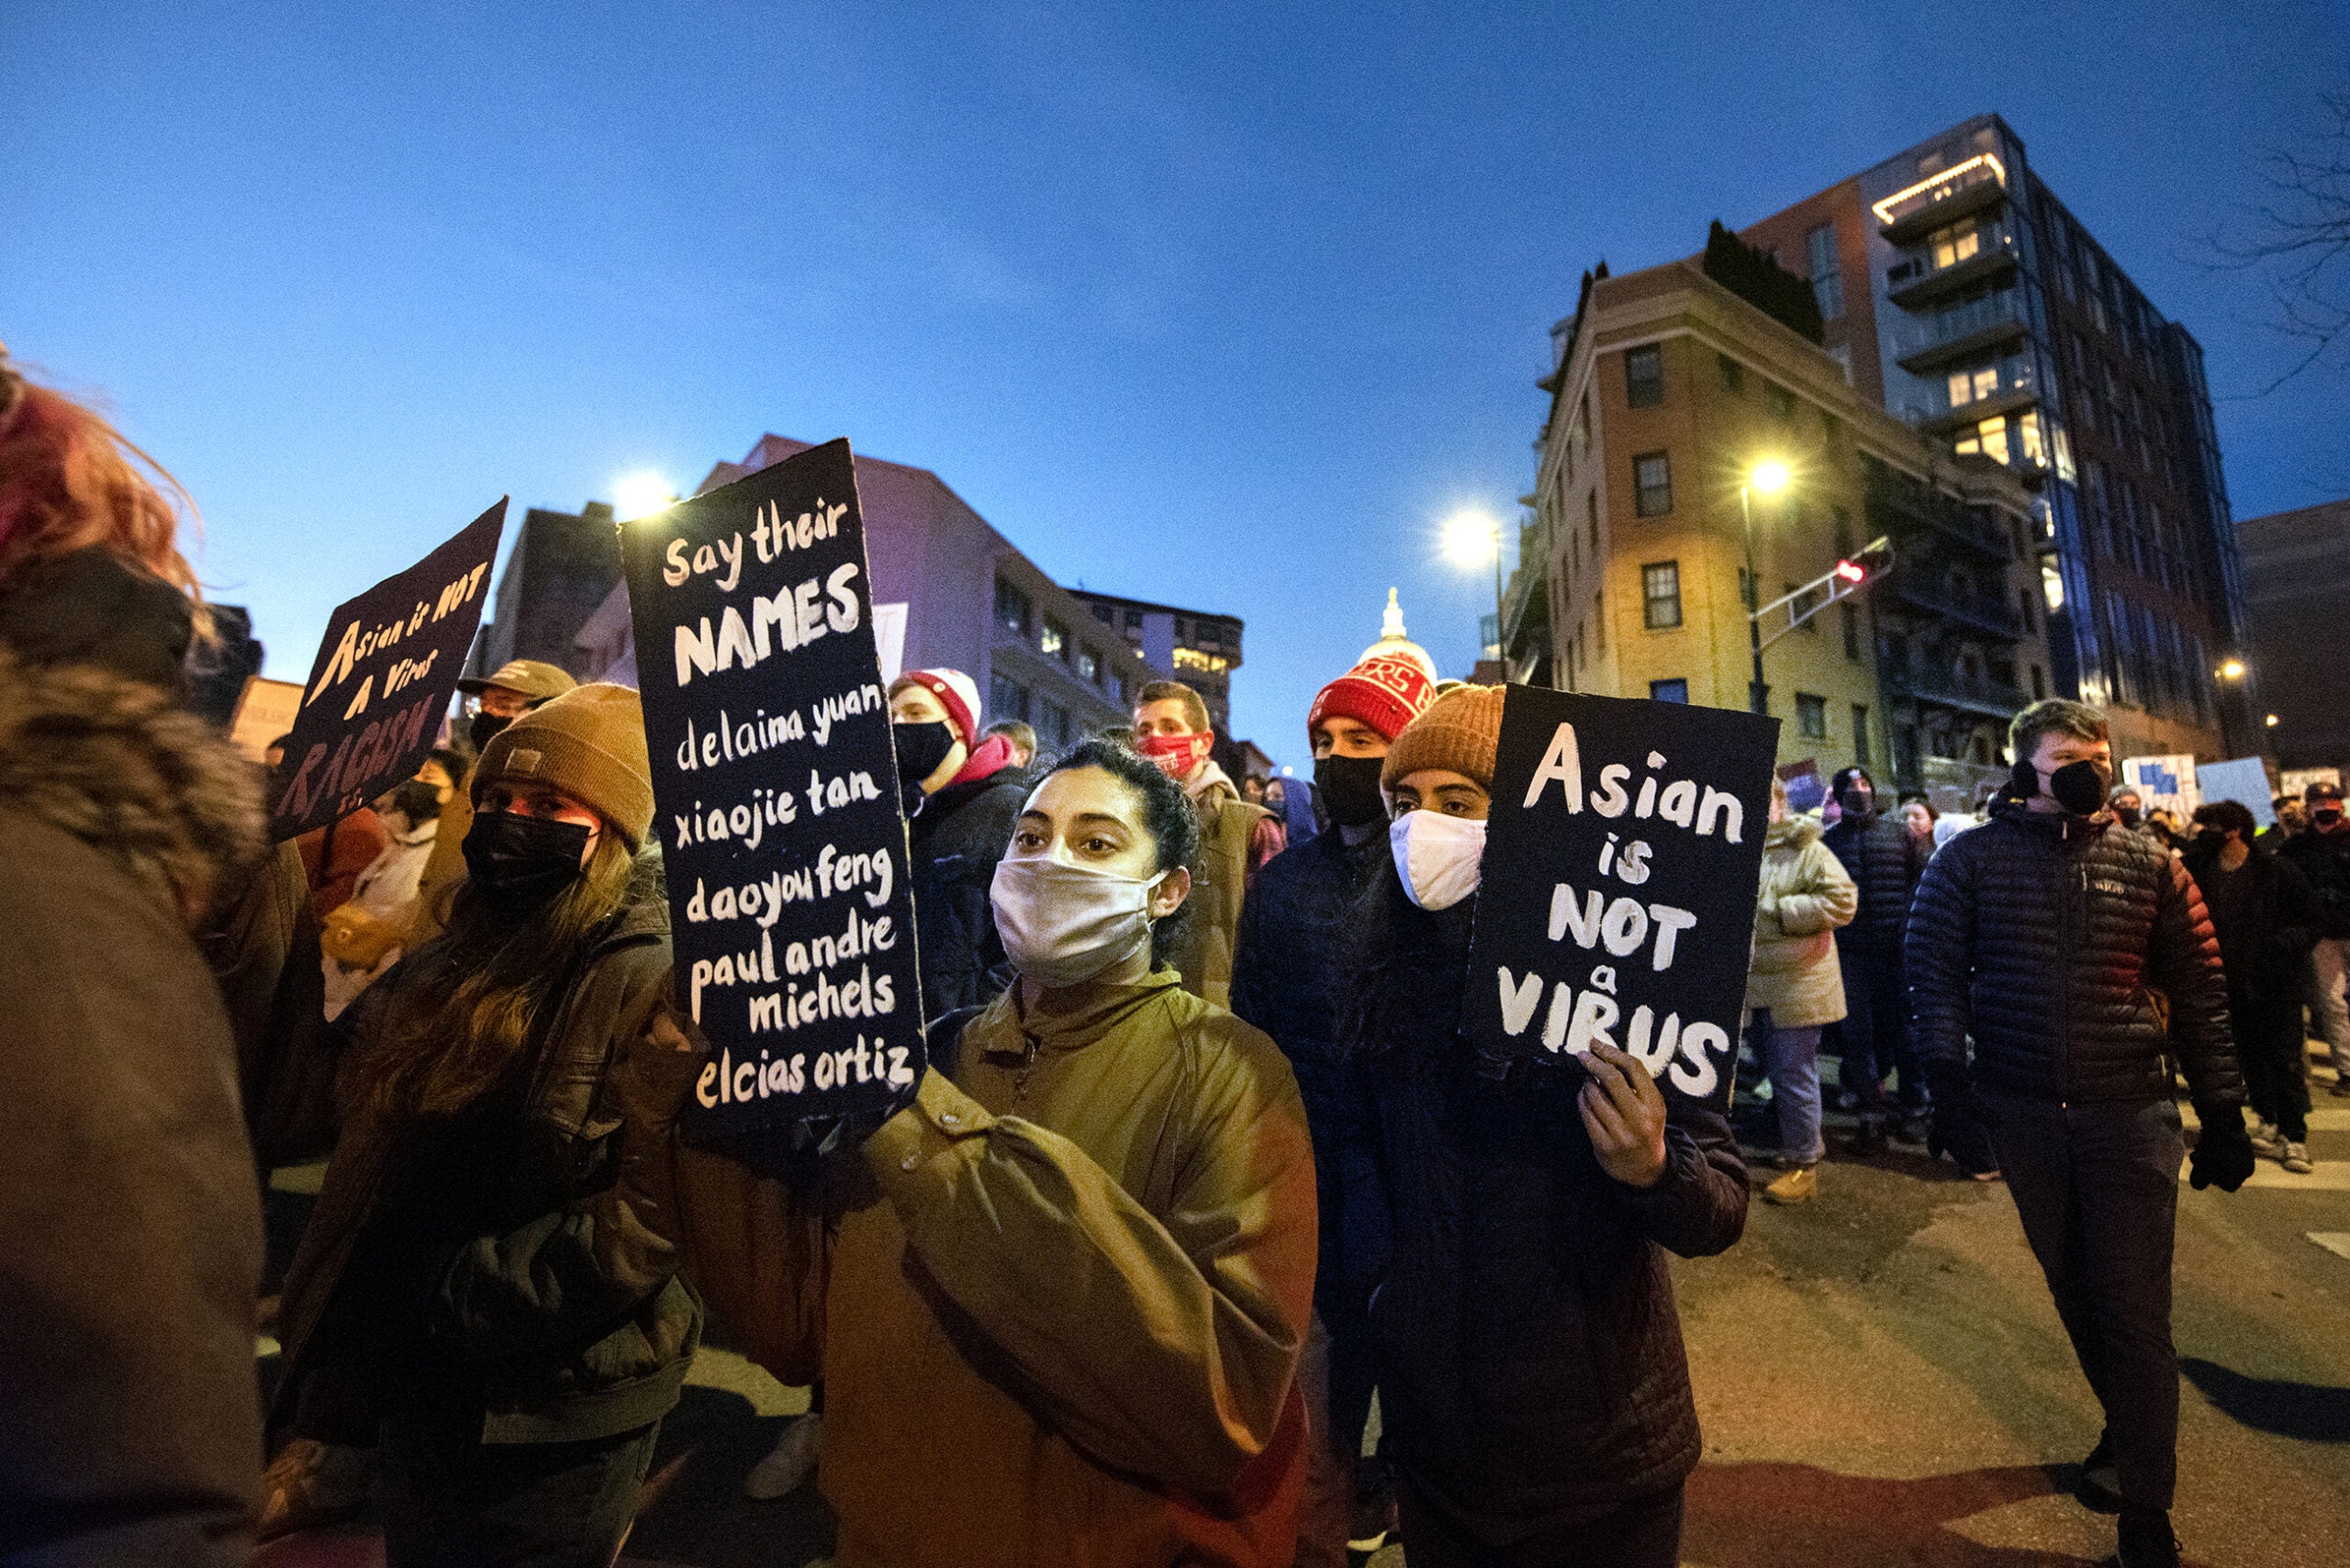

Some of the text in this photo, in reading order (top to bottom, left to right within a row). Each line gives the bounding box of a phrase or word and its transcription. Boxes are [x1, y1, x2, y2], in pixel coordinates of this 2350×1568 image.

[663, 497, 848, 592] Say their
[306, 561, 488, 707] Asian is NOT
[675, 562, 859, 687] NAMES
[343, 648, 439, 721] A Virus
[677, 683, 882, 771] delaina yuan
[276, 692, 436, 822] RACISM
[1522, 722, 1744, 845] Asian
[675, 768, 882, 850] xiaojie tan
[687, 843, 893, 929] daoyou feng
[1598, 832, 1653, 885] is
[690, 906, 897, 1025] paul andre
[1548, 882, 1697, 971] NOT
[749, 962, 895, 1034] michels
[1590, 964, 1618, 995] a
[696, 1033, 914, 1109] elcias ortiz
[1497, 966, 1729, 1098] VIRUS
